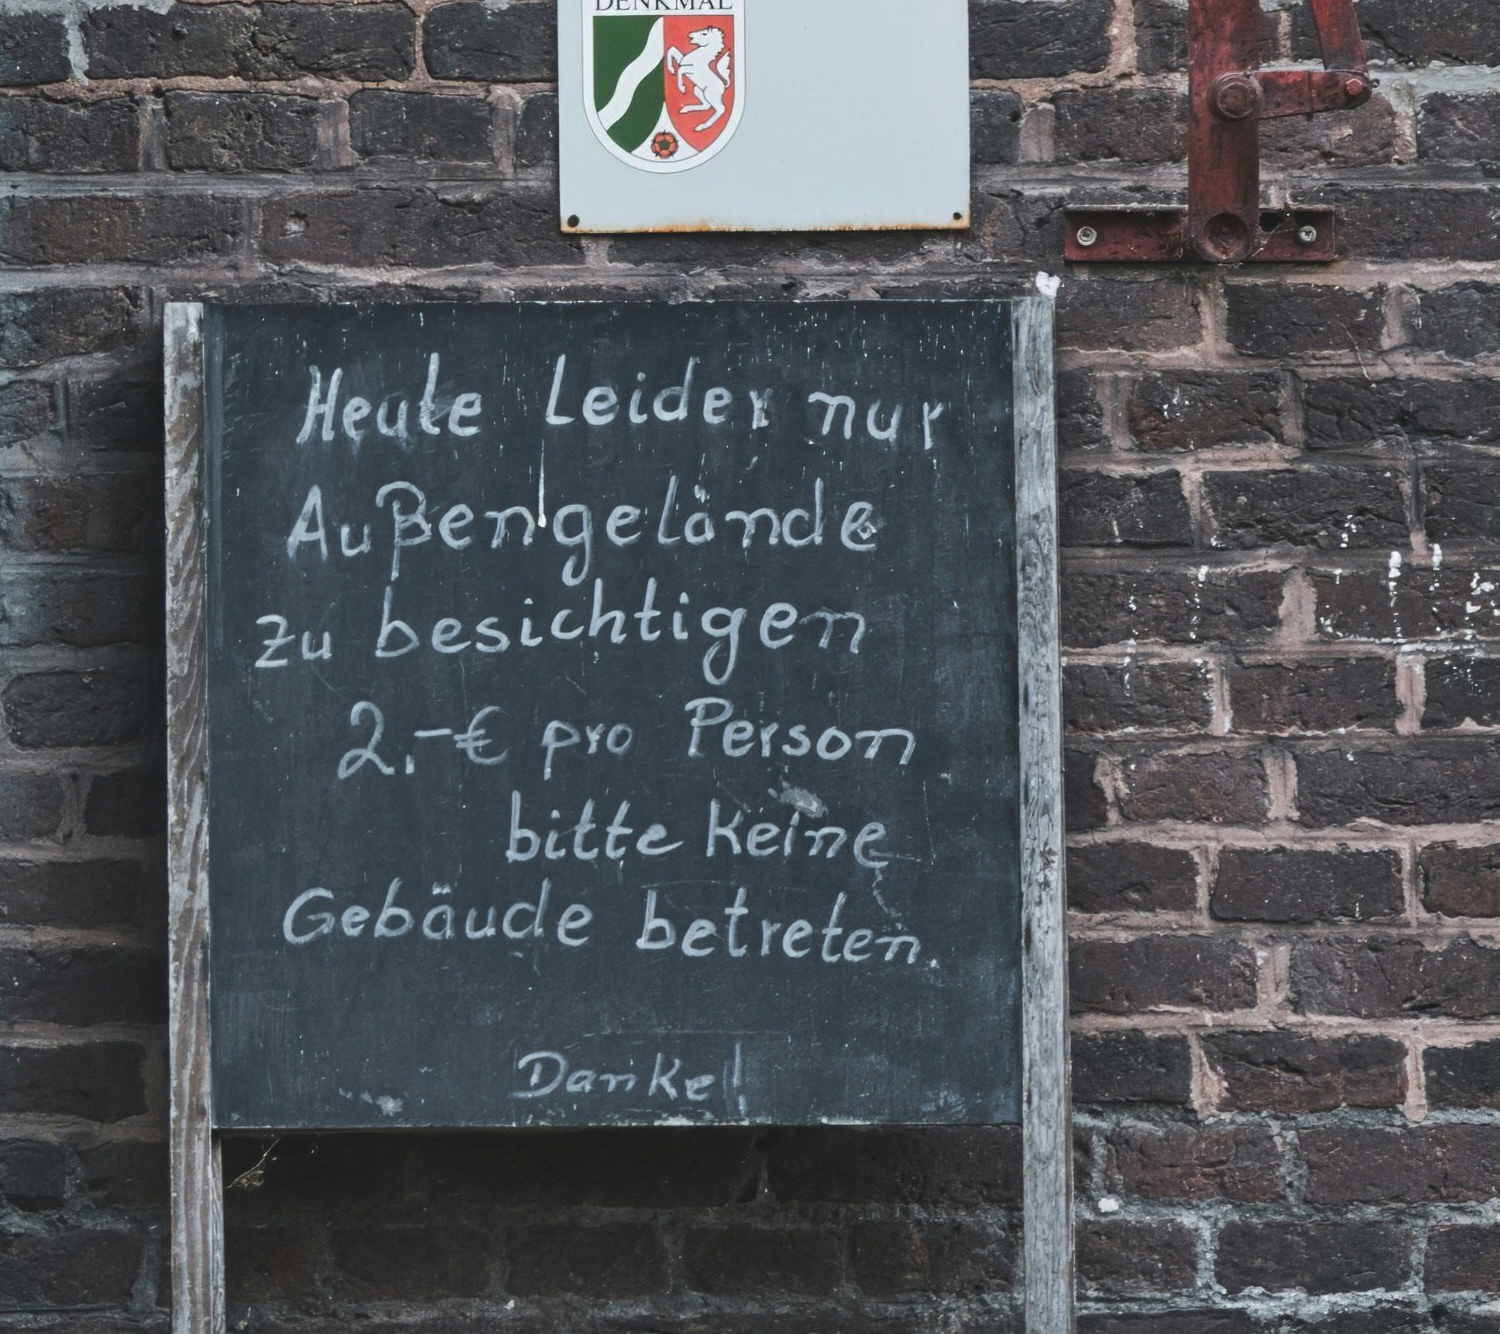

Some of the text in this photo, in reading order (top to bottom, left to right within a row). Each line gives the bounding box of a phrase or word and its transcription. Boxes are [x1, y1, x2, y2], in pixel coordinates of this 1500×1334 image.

[296, 352, 483, 444] Heute
[807, 390, 945, 449] nur
[286, 475, 880, 587] Außengelände
[375, 577, 867, 686] besichtigen
[541, 719, 633, 781] pro
[684, 696, 916, 766] Person
[506, 790, 684, 863] bitte
[283, 877, 593, 947] Gebäude
